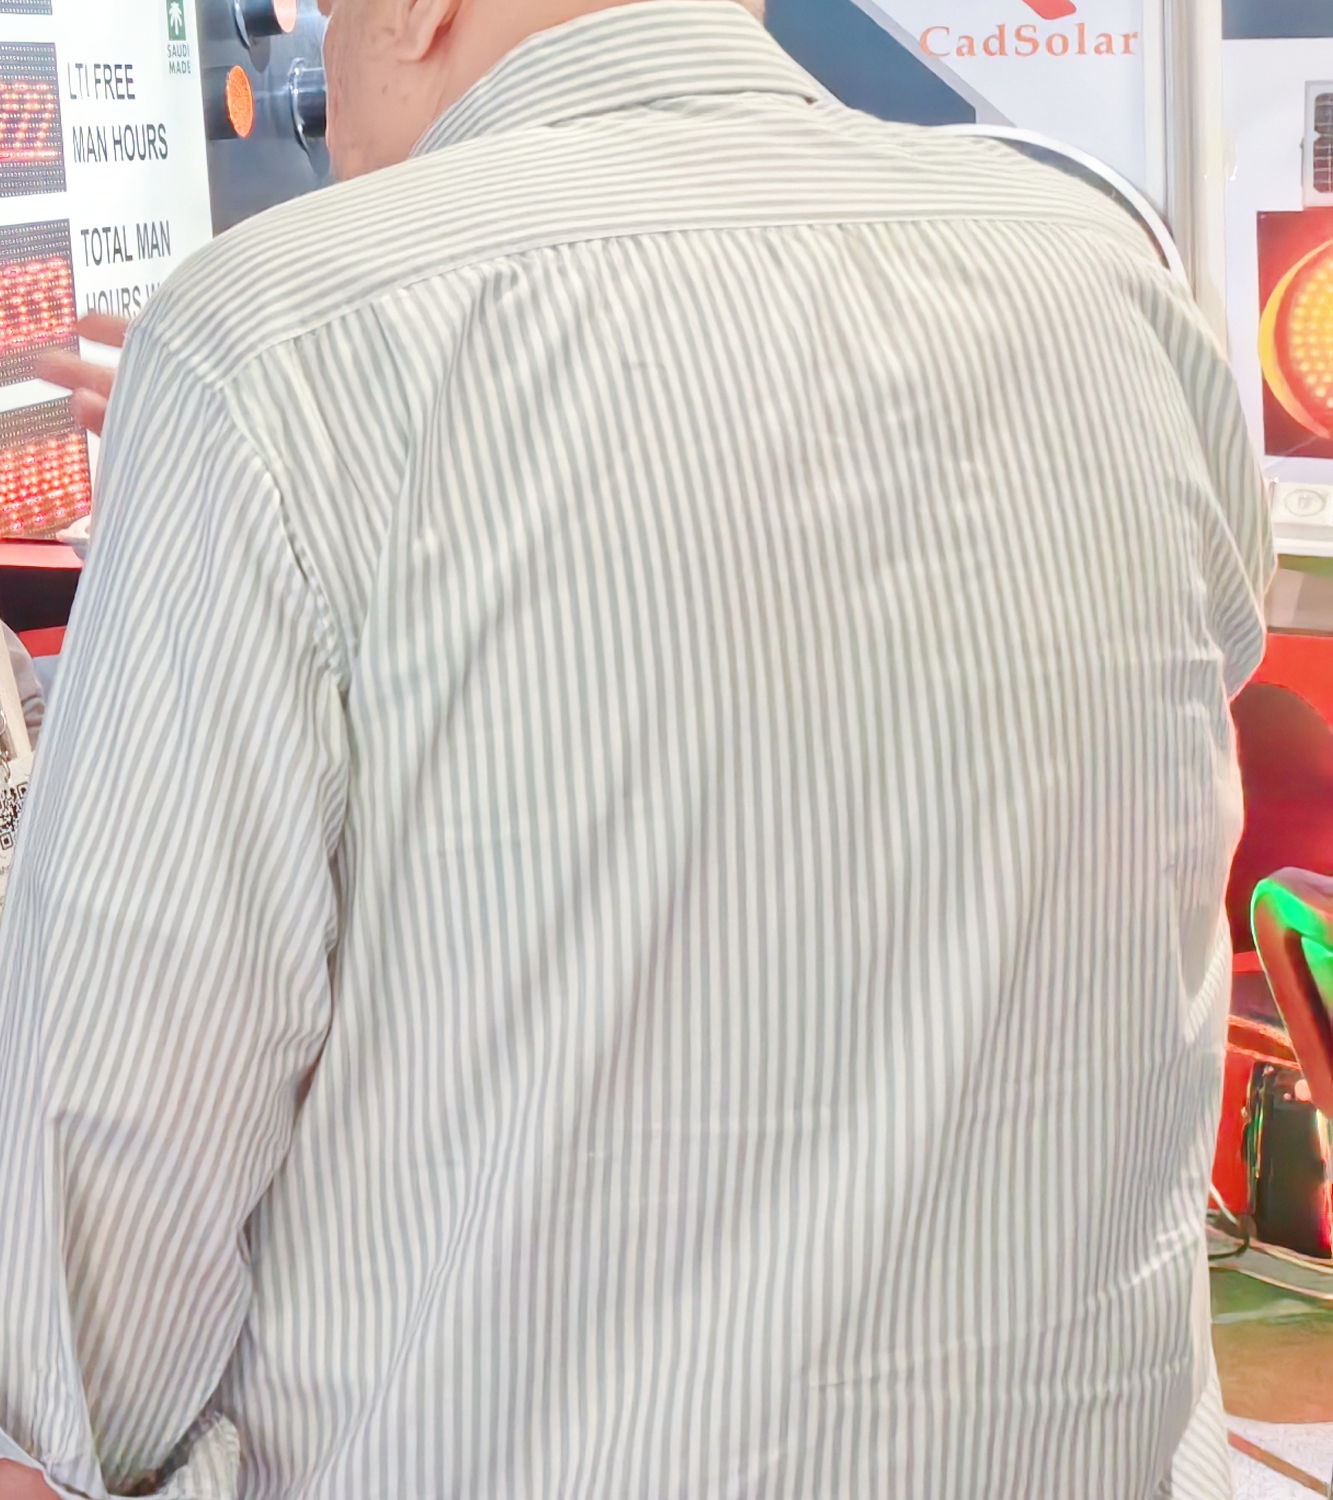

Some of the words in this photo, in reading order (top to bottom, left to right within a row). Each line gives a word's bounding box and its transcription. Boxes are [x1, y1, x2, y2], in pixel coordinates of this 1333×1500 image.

[167, 43, 190, 59] SAUDI
[918, 21, 1140, 58] CadSolar
[67, 62, 90, 100] LTI
[94, 63, 136, 100] FREE
[169, 59, 192, 75] MADE
[72, 125, 108, 163] MAN
[112, 123, 169, 162] HOURS
[81, 226, 133, 267] TOTAL
[136, 220, 171, 260] MAN
